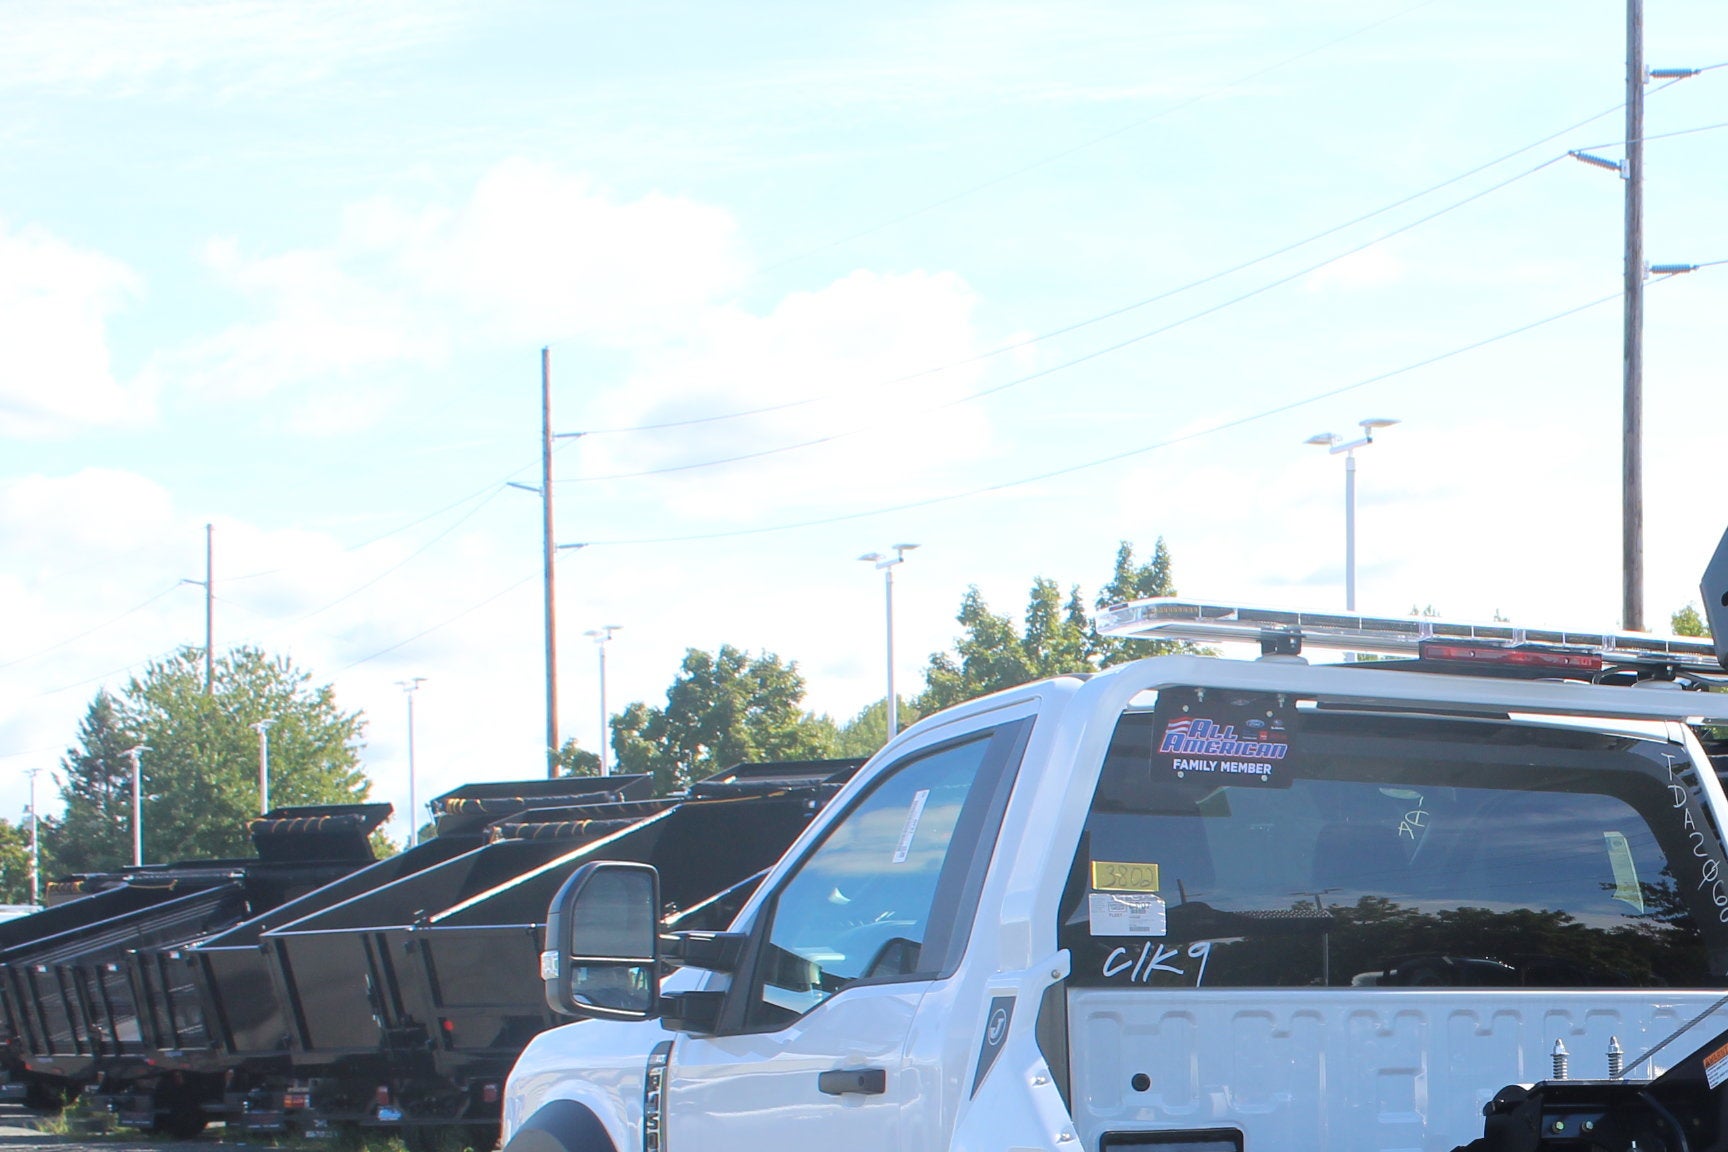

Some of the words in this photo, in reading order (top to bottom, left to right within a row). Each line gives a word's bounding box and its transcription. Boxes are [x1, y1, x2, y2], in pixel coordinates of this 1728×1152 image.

[1187, 718, 1238, 741] ALL
[1159, 732, 1288, 760] AMERICAN
[1172, 758, 1218, 772] FAMILY
[1220, 761, 1272, 775] MEMBER
